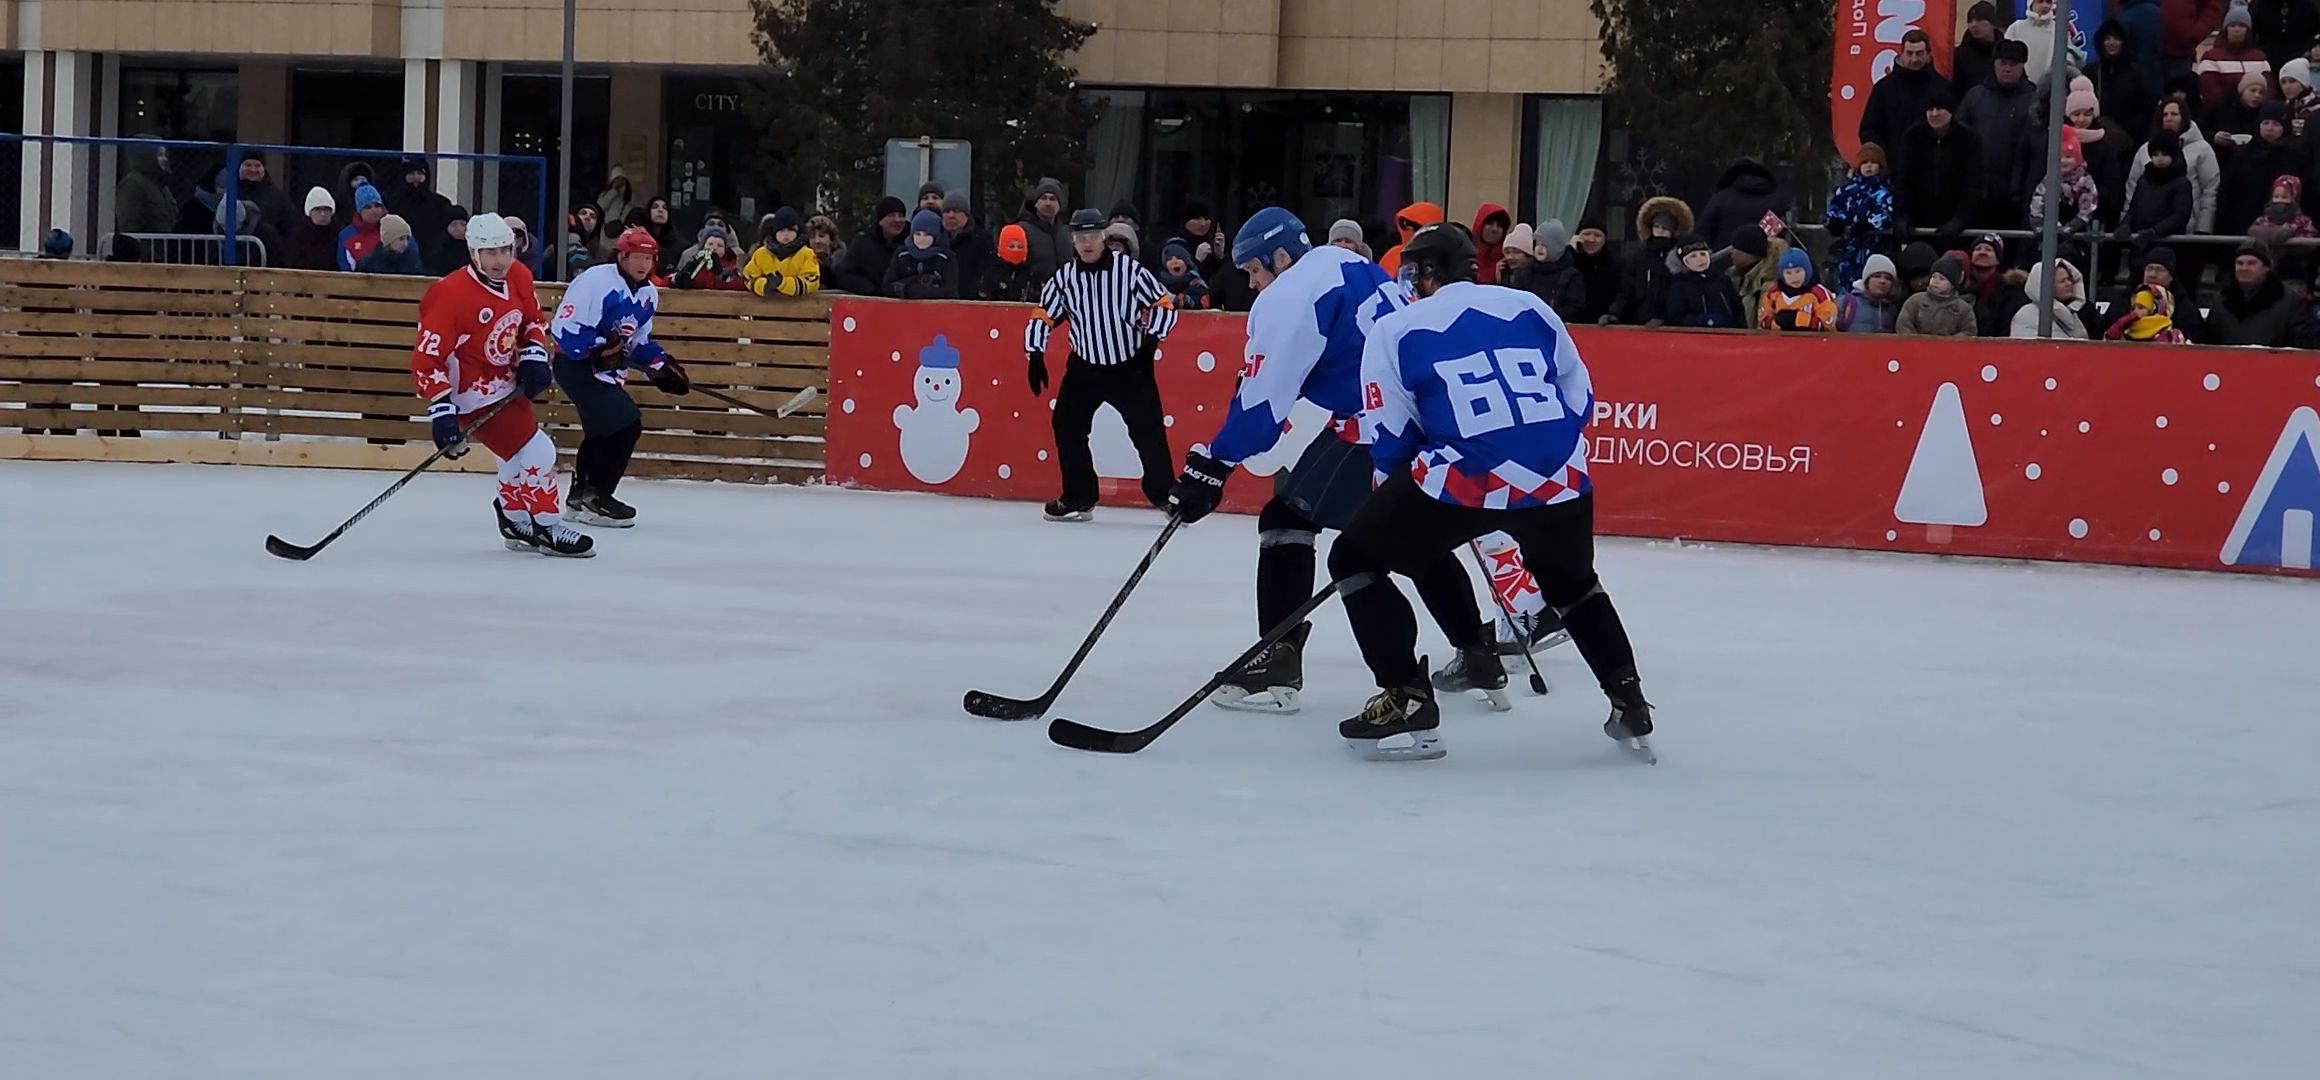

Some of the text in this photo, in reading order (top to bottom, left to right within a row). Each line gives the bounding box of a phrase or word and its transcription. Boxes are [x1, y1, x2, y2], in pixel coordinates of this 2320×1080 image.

[695, 93, 739, 111] CITY
[417, 330, 441, 357] 72
[1432, 347, 1566, 439] 69
[1588, 401, 1658, 430] РКИ
